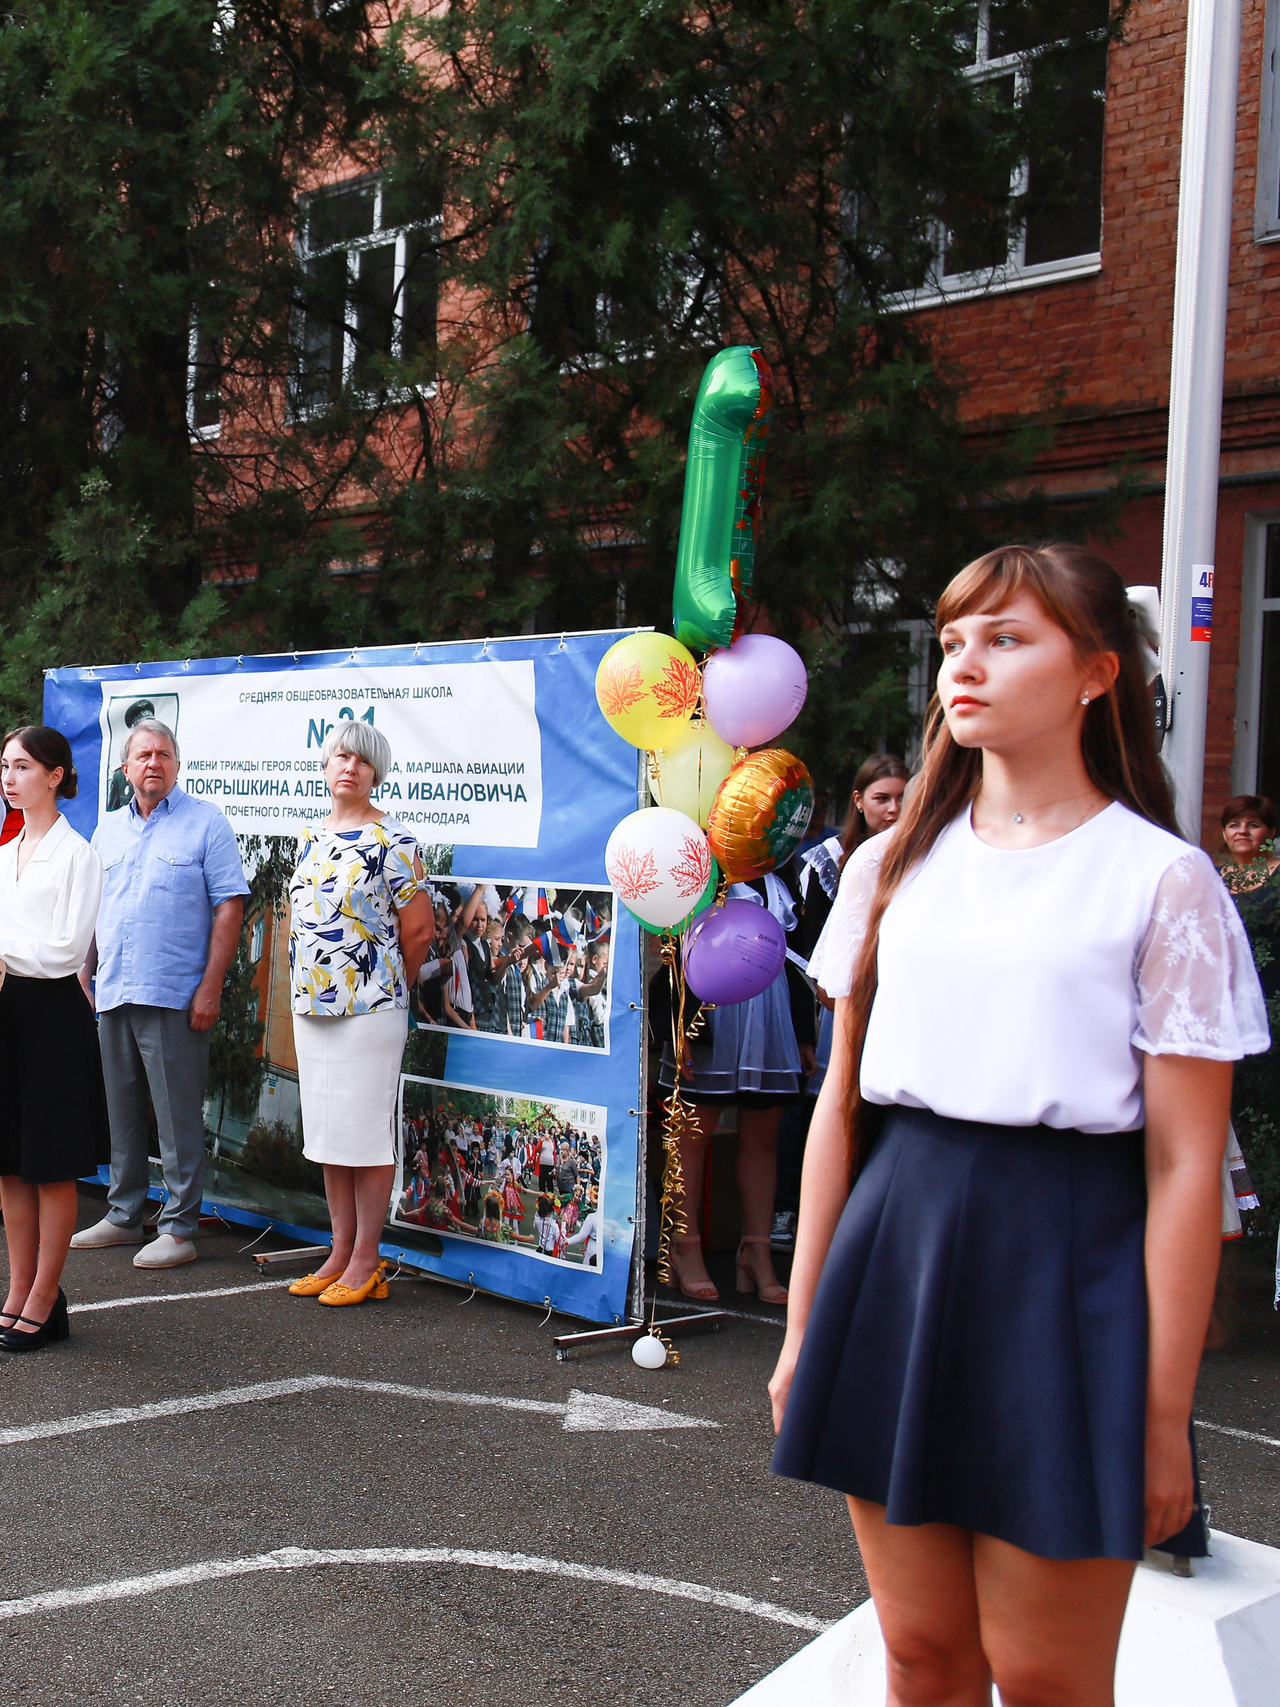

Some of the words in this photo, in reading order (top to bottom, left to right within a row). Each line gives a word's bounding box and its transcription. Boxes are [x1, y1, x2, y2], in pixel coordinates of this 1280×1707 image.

[239, 691, 283, 704] СРЕДНЯЯ
[286, 688, 409, 702] ОБЩЕОБРАЗОВАТЕЛЬНАЯ
[413, 686, 453, 699] ШКОЛА
[187, 760, 218, 771] ИМЕНИ
[220, 760, 259, 773] ТРИЖДЫ
[261, 760, 292, 772] ГЕРОЯ
[406, 761, 464, 775] МАРШАЛА
[466, 762, 525, 776] АВИАЦИИ
[186, 778, 290, 797] ПОКРЫШКИНА
[294, 779, 402, 803] АЛЕКДРА
[408, 782, 528, 803] ИВАНОВИЧА
[225, 805, 280, 818] ПОЧЕТНОГО
[282, 807, 332, 821] ГРАЖДАНИ
[395, 811, 470, 826] КРАСНОДАРА
